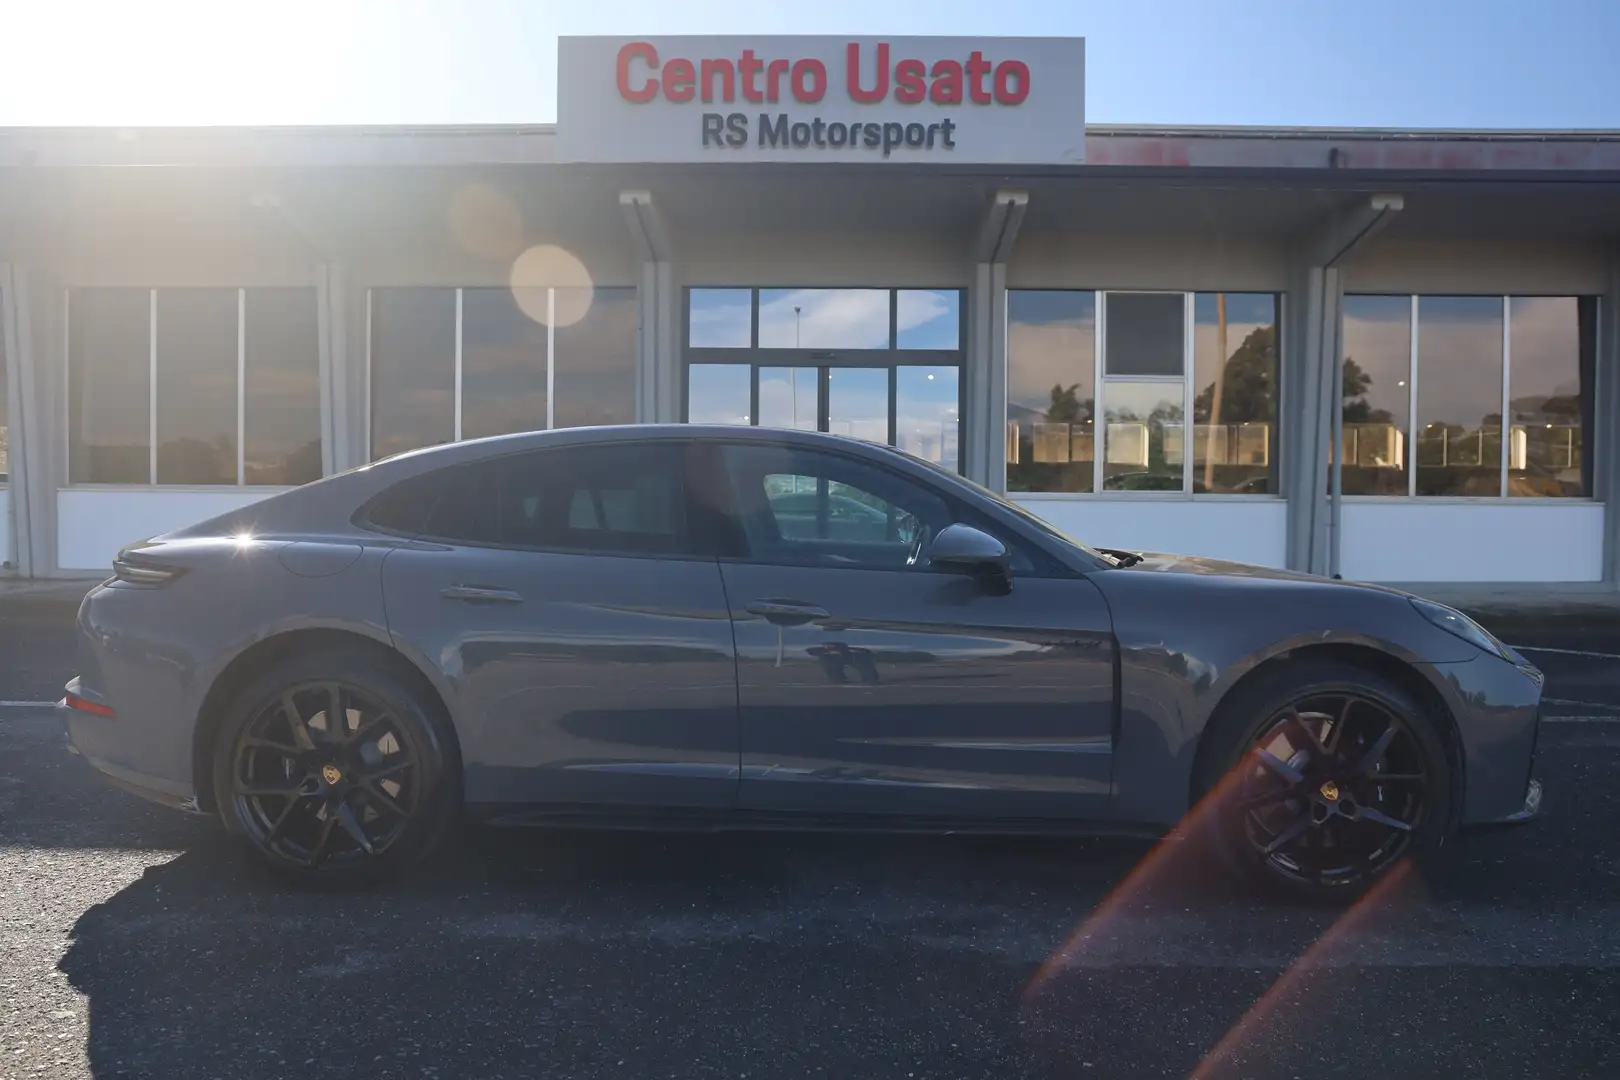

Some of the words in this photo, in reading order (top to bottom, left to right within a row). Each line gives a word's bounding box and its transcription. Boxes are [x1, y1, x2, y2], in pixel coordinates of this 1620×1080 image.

[616, 42, 828, 104] Centro
[847, 42, 1031, 104] Usato
[702, 113, 748, 148] RS
[758, 113, 956, 157] Motorsport
